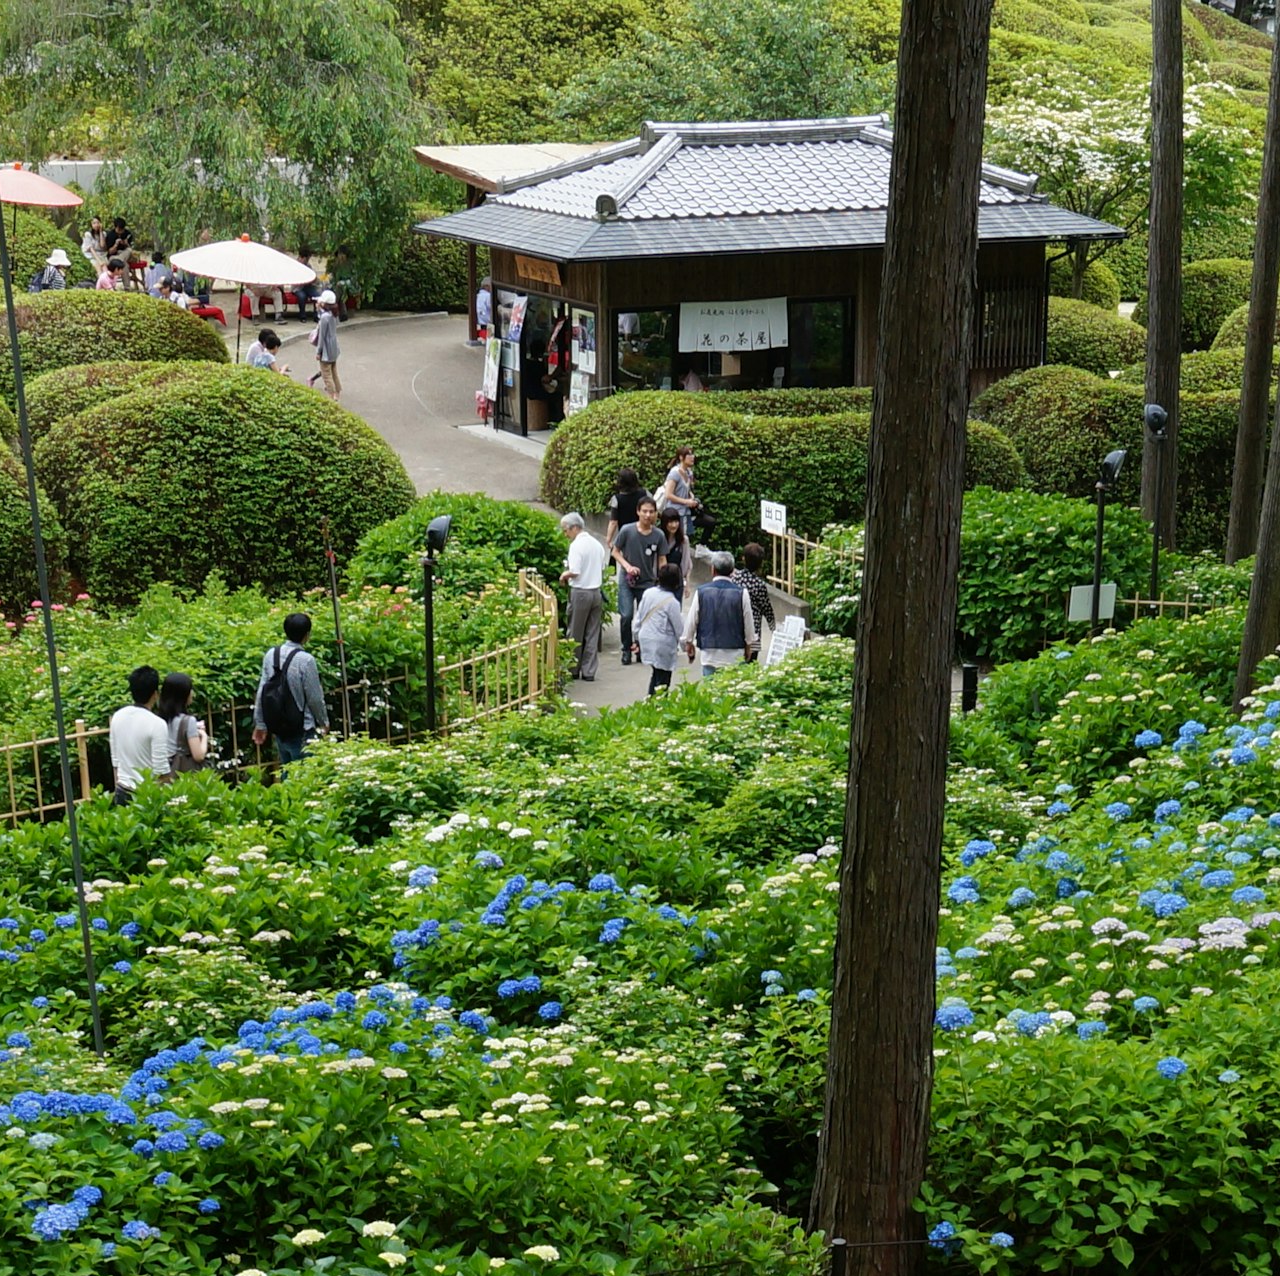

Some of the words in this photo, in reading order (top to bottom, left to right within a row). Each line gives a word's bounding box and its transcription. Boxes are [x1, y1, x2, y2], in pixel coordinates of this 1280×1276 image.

[700, 331, 767, 346] 花の茶屋
[765, 507, 782, 521] 出口
